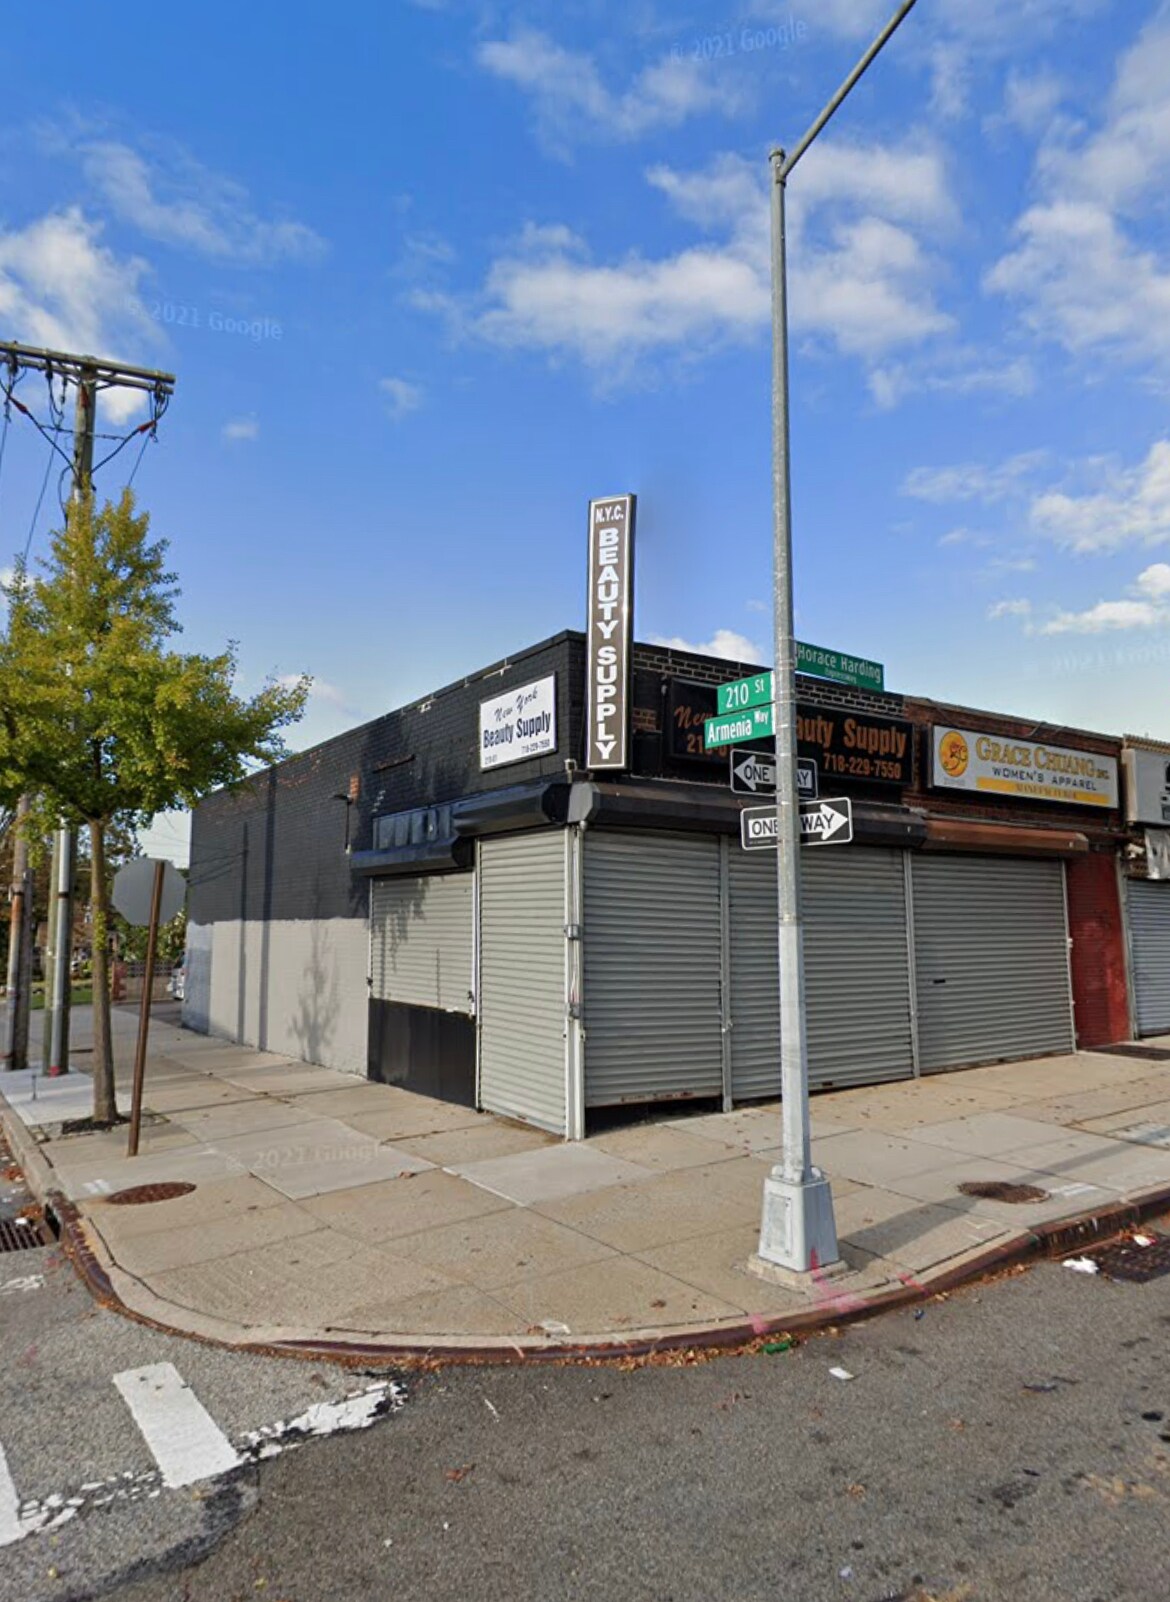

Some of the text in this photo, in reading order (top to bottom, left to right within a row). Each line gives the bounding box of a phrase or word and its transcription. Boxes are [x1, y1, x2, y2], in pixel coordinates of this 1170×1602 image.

[596, 527, 620, 640] BEAUTY
[798, 644, 881, 684] Horace Harding
[595, 645, 618, 761] SUPPLY
[725, 679, 765, 709] 210 St
[483, 710, 551, 749] Beauty Supply
[707, 711, 769, 744] Armenia Way
[796, 715, 834, 748] auty
[843, 718, 907, 758] Supply
[976, 737, 1032, 767] GRACE
[744, 765, 770, 782] ONE
[992, 767, 1096, 791] WOMEN'S APPAREL
[752, 813, 834, 836] ONE WAY
